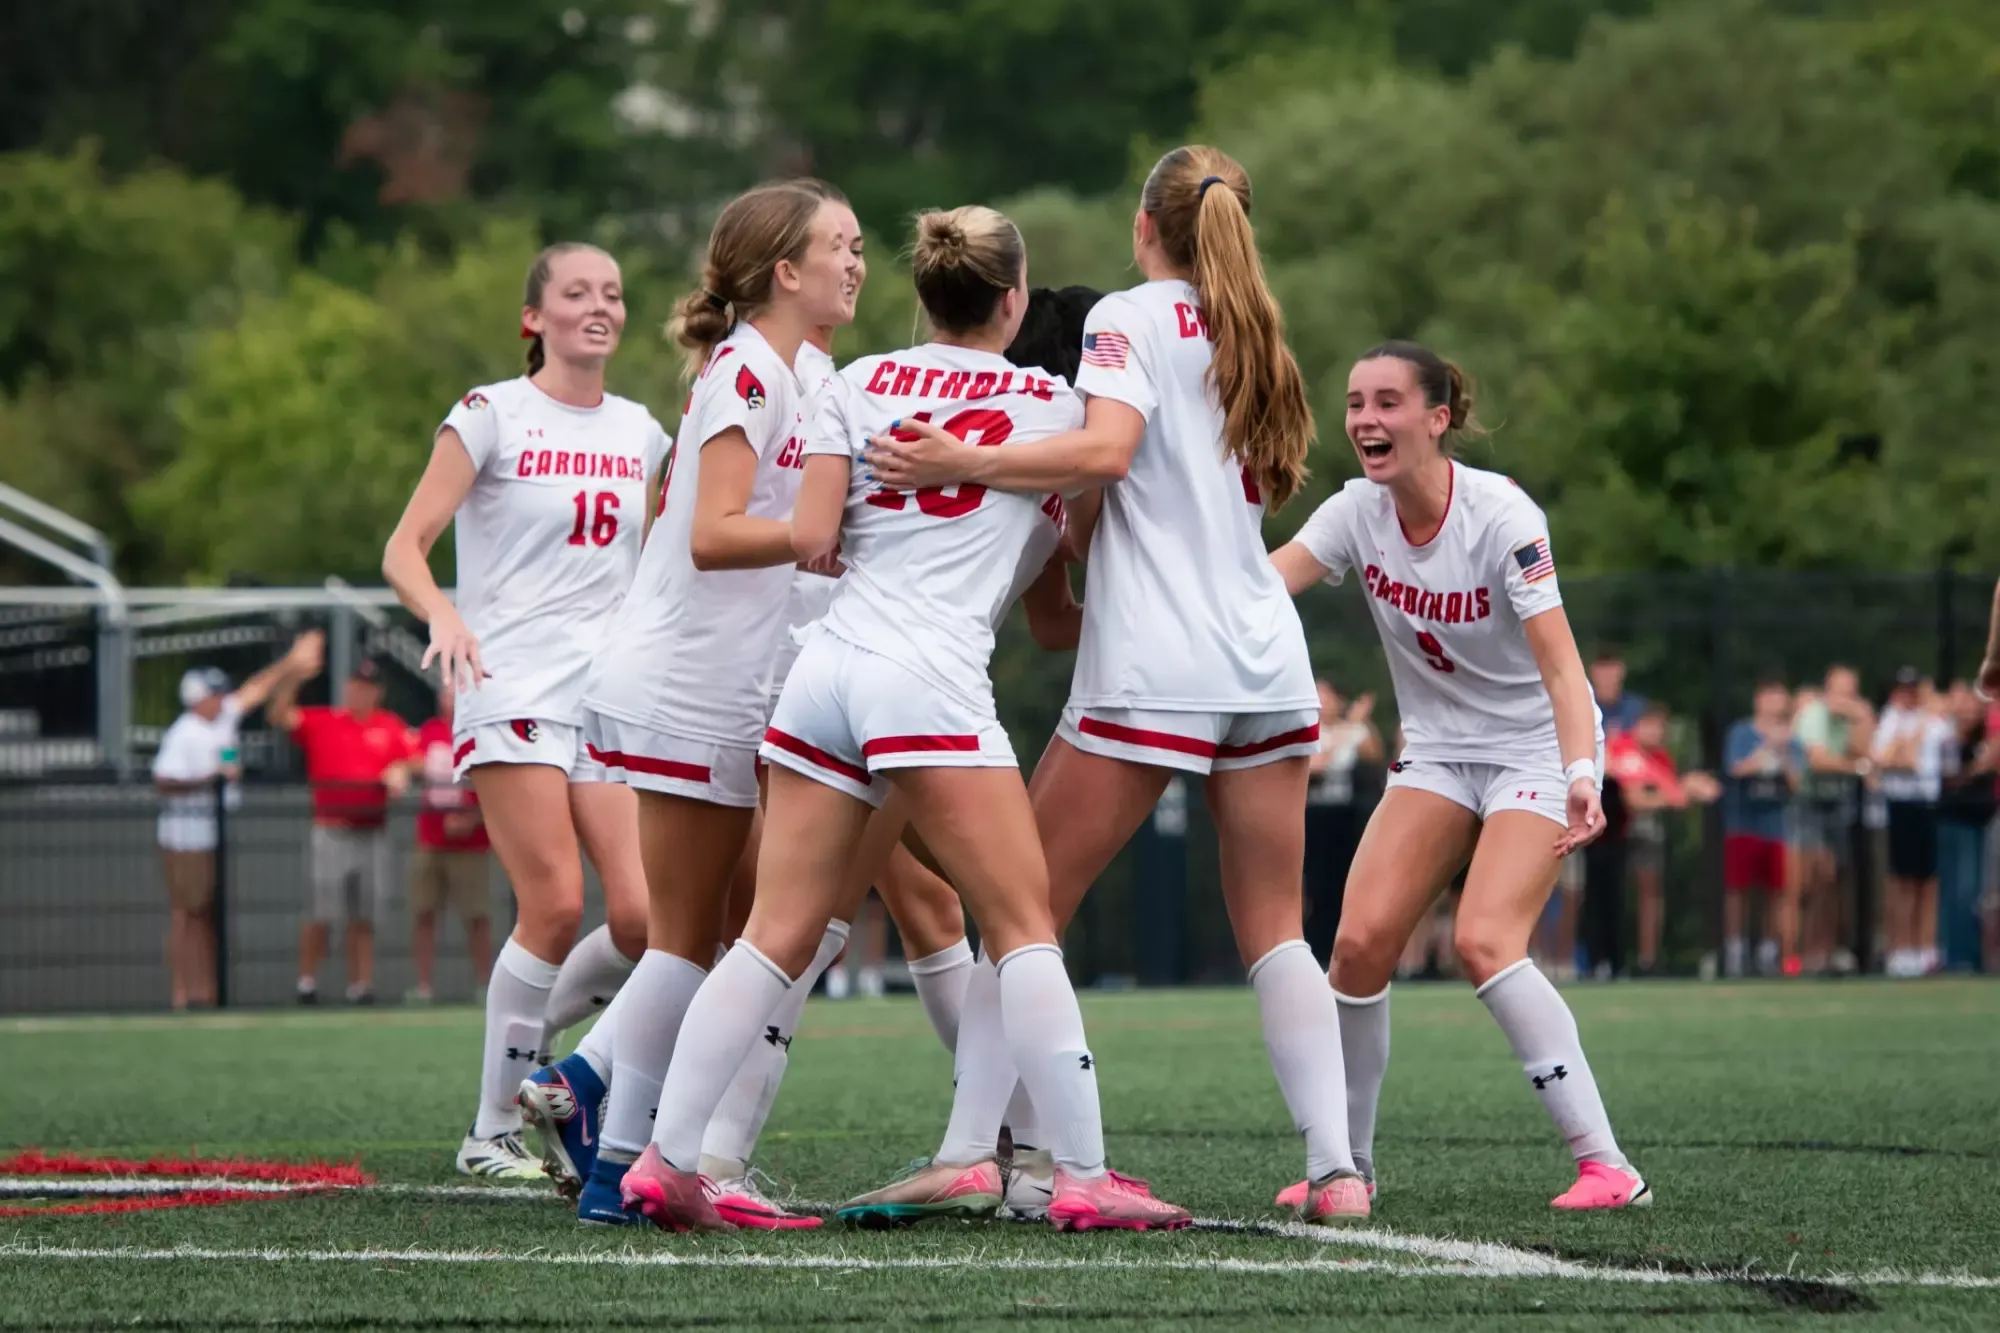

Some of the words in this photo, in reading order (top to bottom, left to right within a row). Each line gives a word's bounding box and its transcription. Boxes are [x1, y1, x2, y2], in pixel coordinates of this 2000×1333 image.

[516, 450, 644, 481] CARDINAS
[567, 489, 621, 548] 16
[1365, 563, 1491, 624] CARDINALS
[1415, 629, 1456, 674] 9
